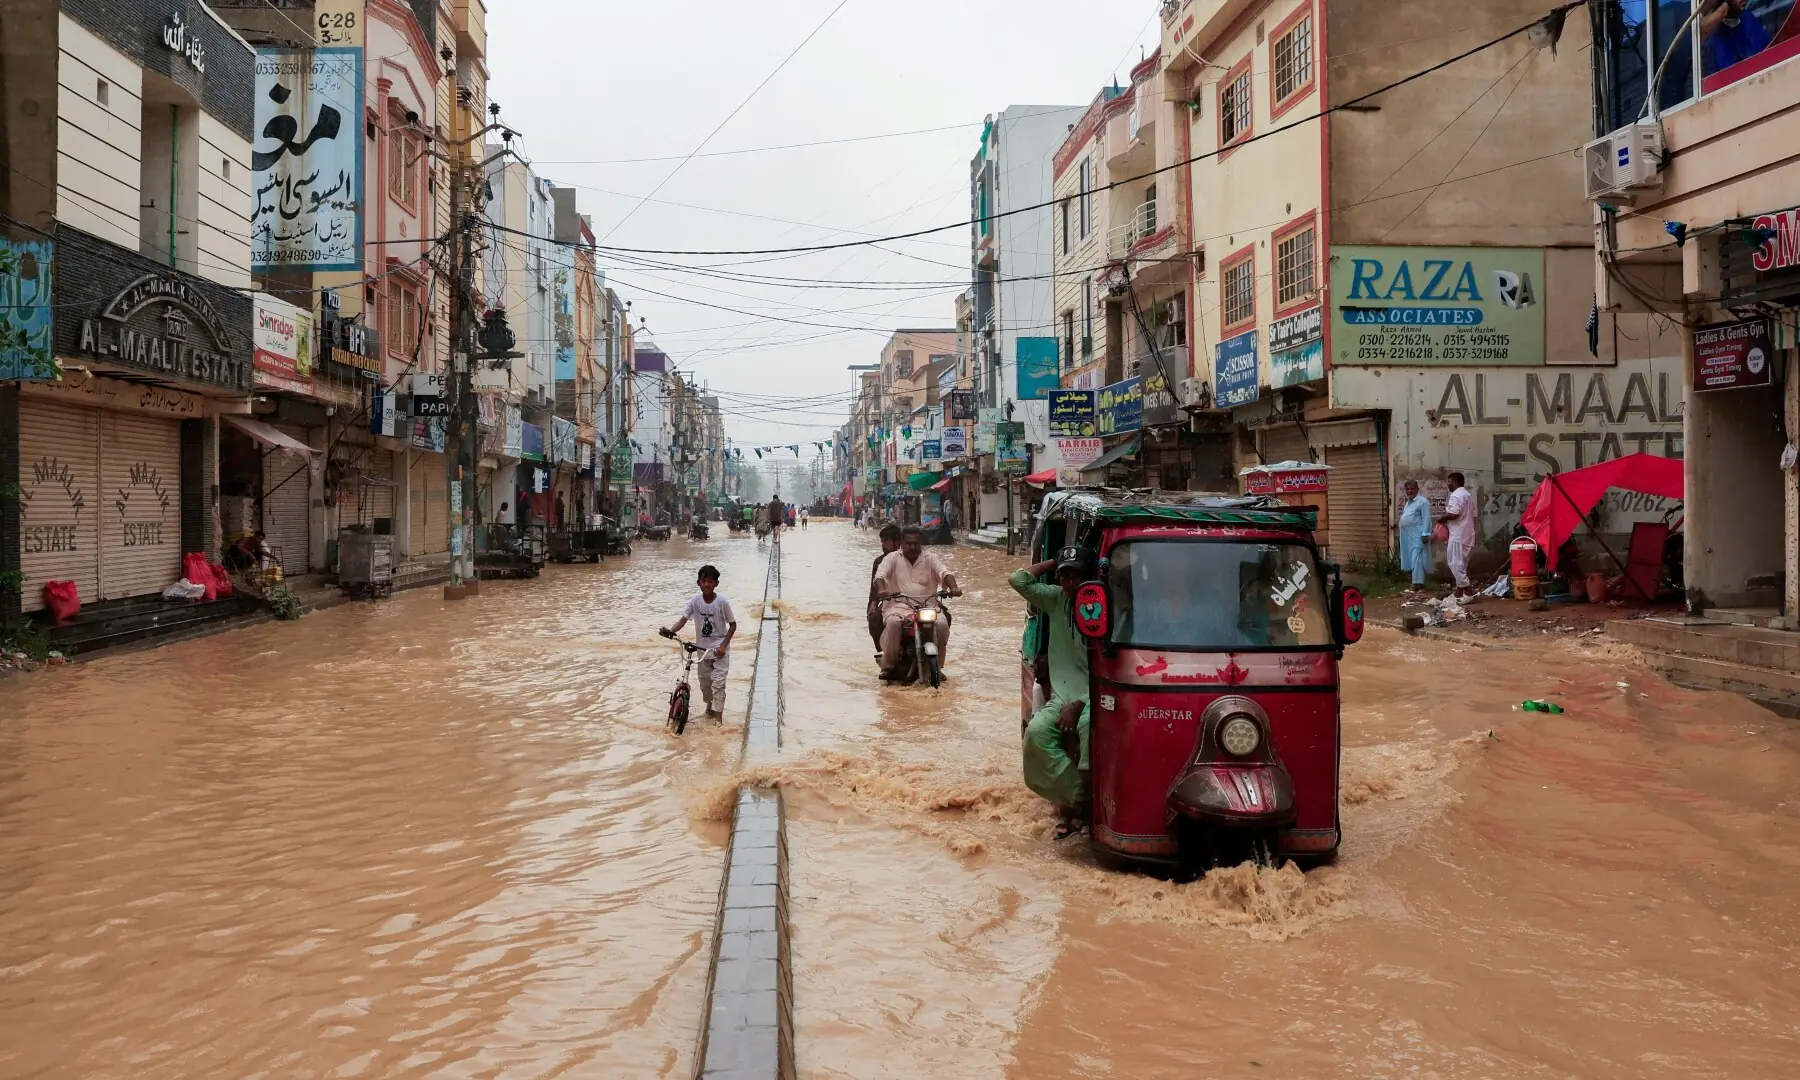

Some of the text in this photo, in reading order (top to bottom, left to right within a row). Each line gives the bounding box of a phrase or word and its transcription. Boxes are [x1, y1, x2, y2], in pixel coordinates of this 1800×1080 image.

[318, 12, 356, 28] C-28
[252, 82, 342, 172] مغ
[133, 279, 186, 304] AL-MAALIK
[1346, 259, 1485, 301] RAZA
[1354, 308, 1476, 324] ASSOCIATES
[80, 318, 187, 373] AL-MAALIK
[1695, 333, 1718, 345] Ladies
[1720, 328, 1725, 341] &
[1727, 325, 1748, 340] Gents
[421, 402, 449, 413] PAP
[1058, 439, 1100, 448] LARAIB
[24, 526, 77, 553] ESTATE
[123, 522, 164, 547] ESTATE
